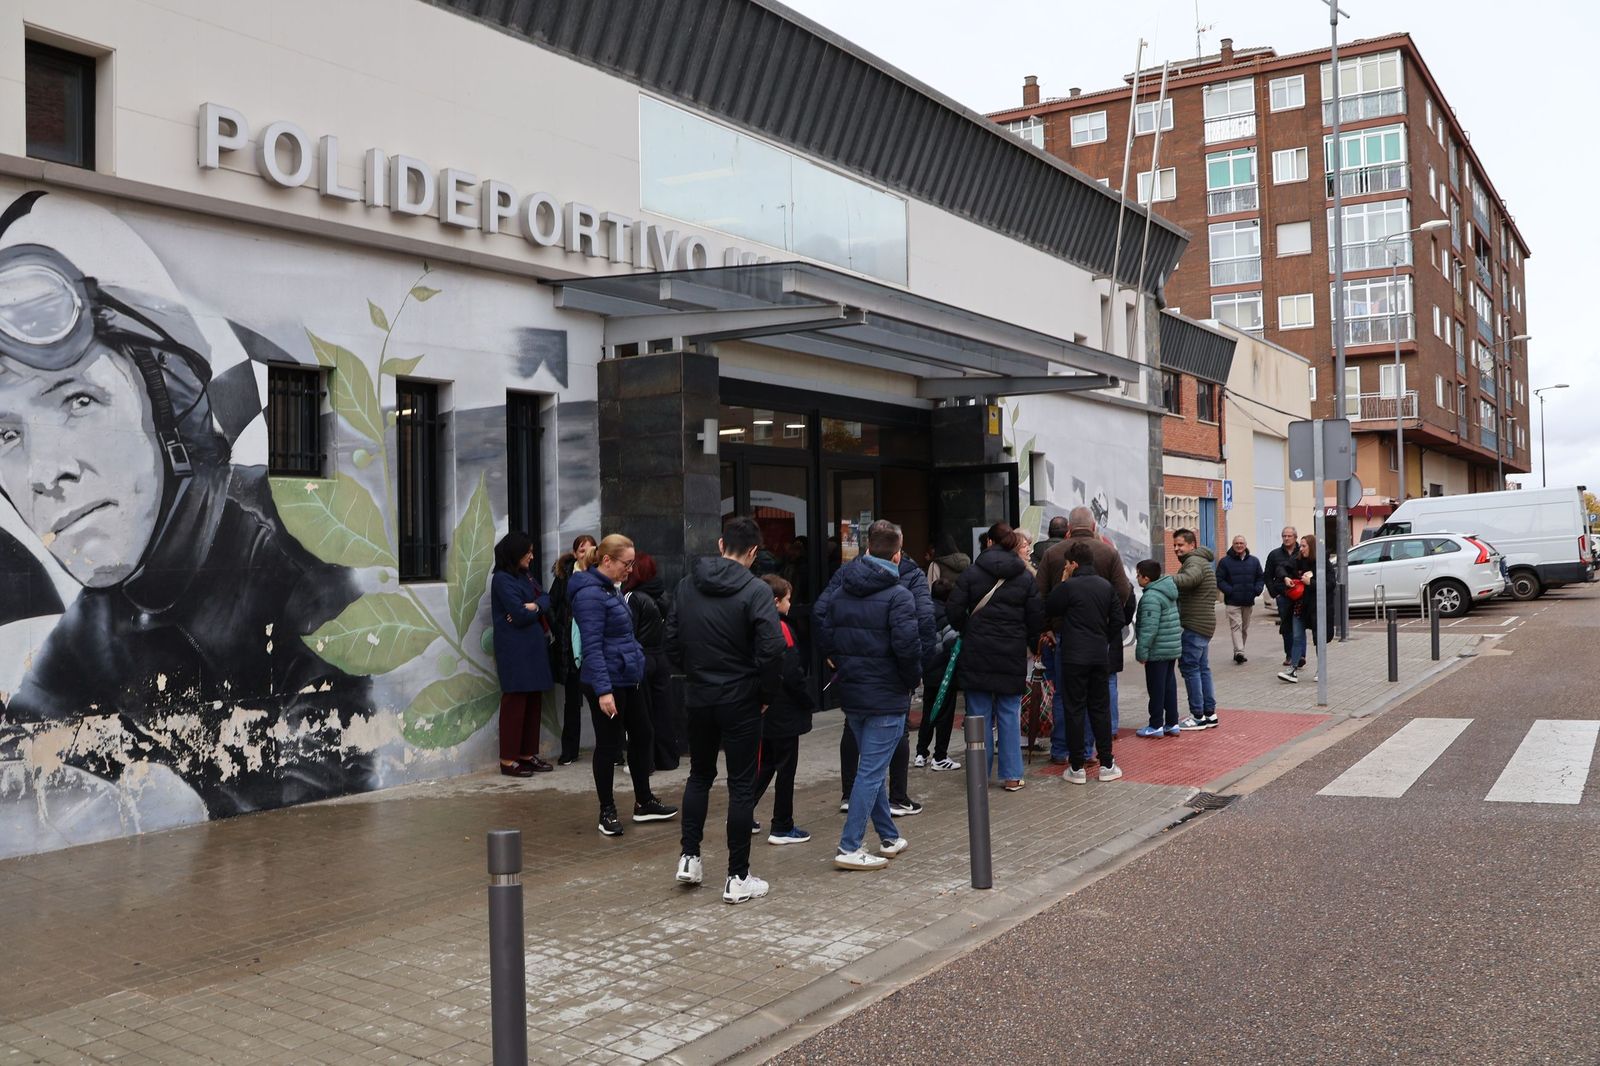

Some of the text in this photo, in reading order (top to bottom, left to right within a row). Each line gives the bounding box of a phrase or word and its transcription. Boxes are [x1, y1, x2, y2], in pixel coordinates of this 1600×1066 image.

[198, 102, 711, 271] POLIDEPORTIVO
[1225, 483, 1232, 502] P
[1326, 508, 1337, 516] Ba
